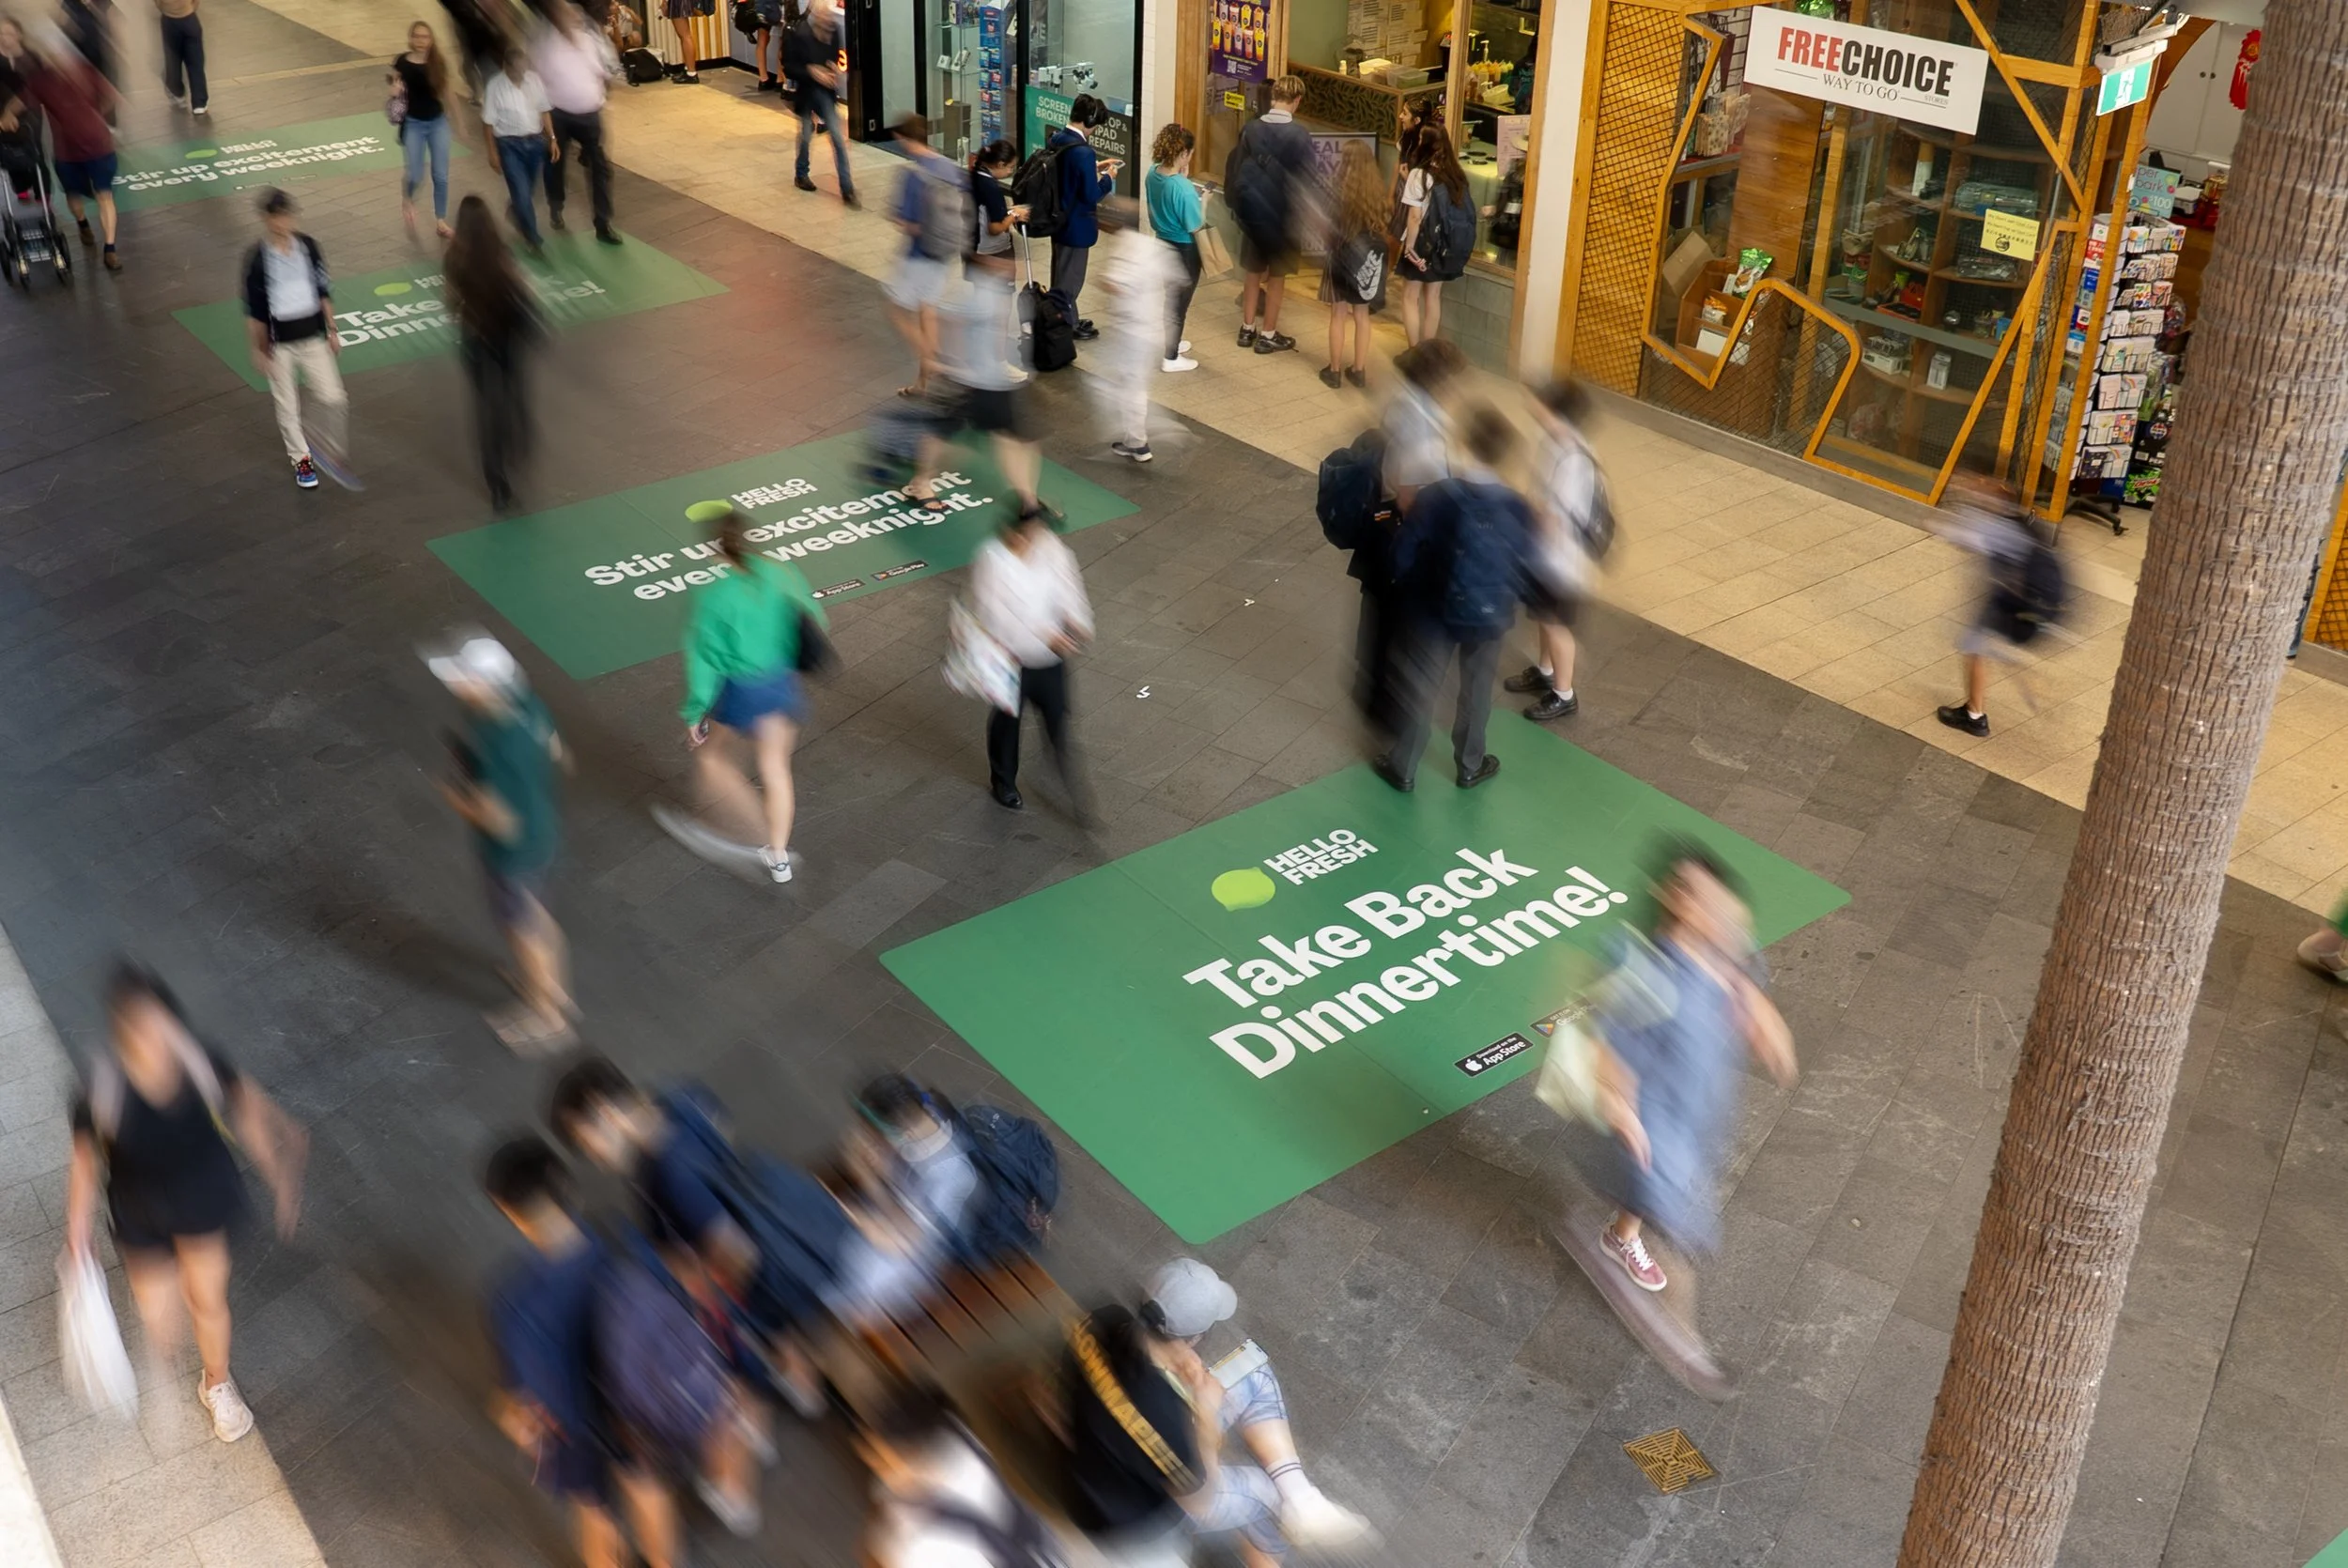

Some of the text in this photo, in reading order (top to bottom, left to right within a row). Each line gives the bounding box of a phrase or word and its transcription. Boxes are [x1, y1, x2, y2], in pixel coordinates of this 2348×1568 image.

[1823, 73, 1899, 101] WAY TO GO
[1924, 95, 1949, 106] STORES
[1036, 106, 1070, 126] BROKEN
[1038, 96, 1072, 114] SCREEN
[170, 162, 209, 178] up
[213, 135, 380, 169] excitement
[1089, 134, 1126, 155] REPAIRS
[1311, 141, 1343, 154] EAL
[128, 170, 219, 192] every
[220, 145, 386, 177] weeknight.
[2150, 194, 2172, 210] $100
[332, 299, 445, 328] Take
[731, 478, 807, 503] HELLO
[742, 483, 818, 510] FRESH
[583, 550, 674, 587] Stir
[742, 470, 972, 545] excitemnt
[633, 562, 734, 601] ever
[1263, 828, 1357, 874] HELLO
[1280, 838, 1379, 886] FRESH
[1182, 847, 1539, 1008] Take Back
[1208, 865, 1630, 1080] Dinnertime!
[1483, 1040, 1526, 1066] App Store
